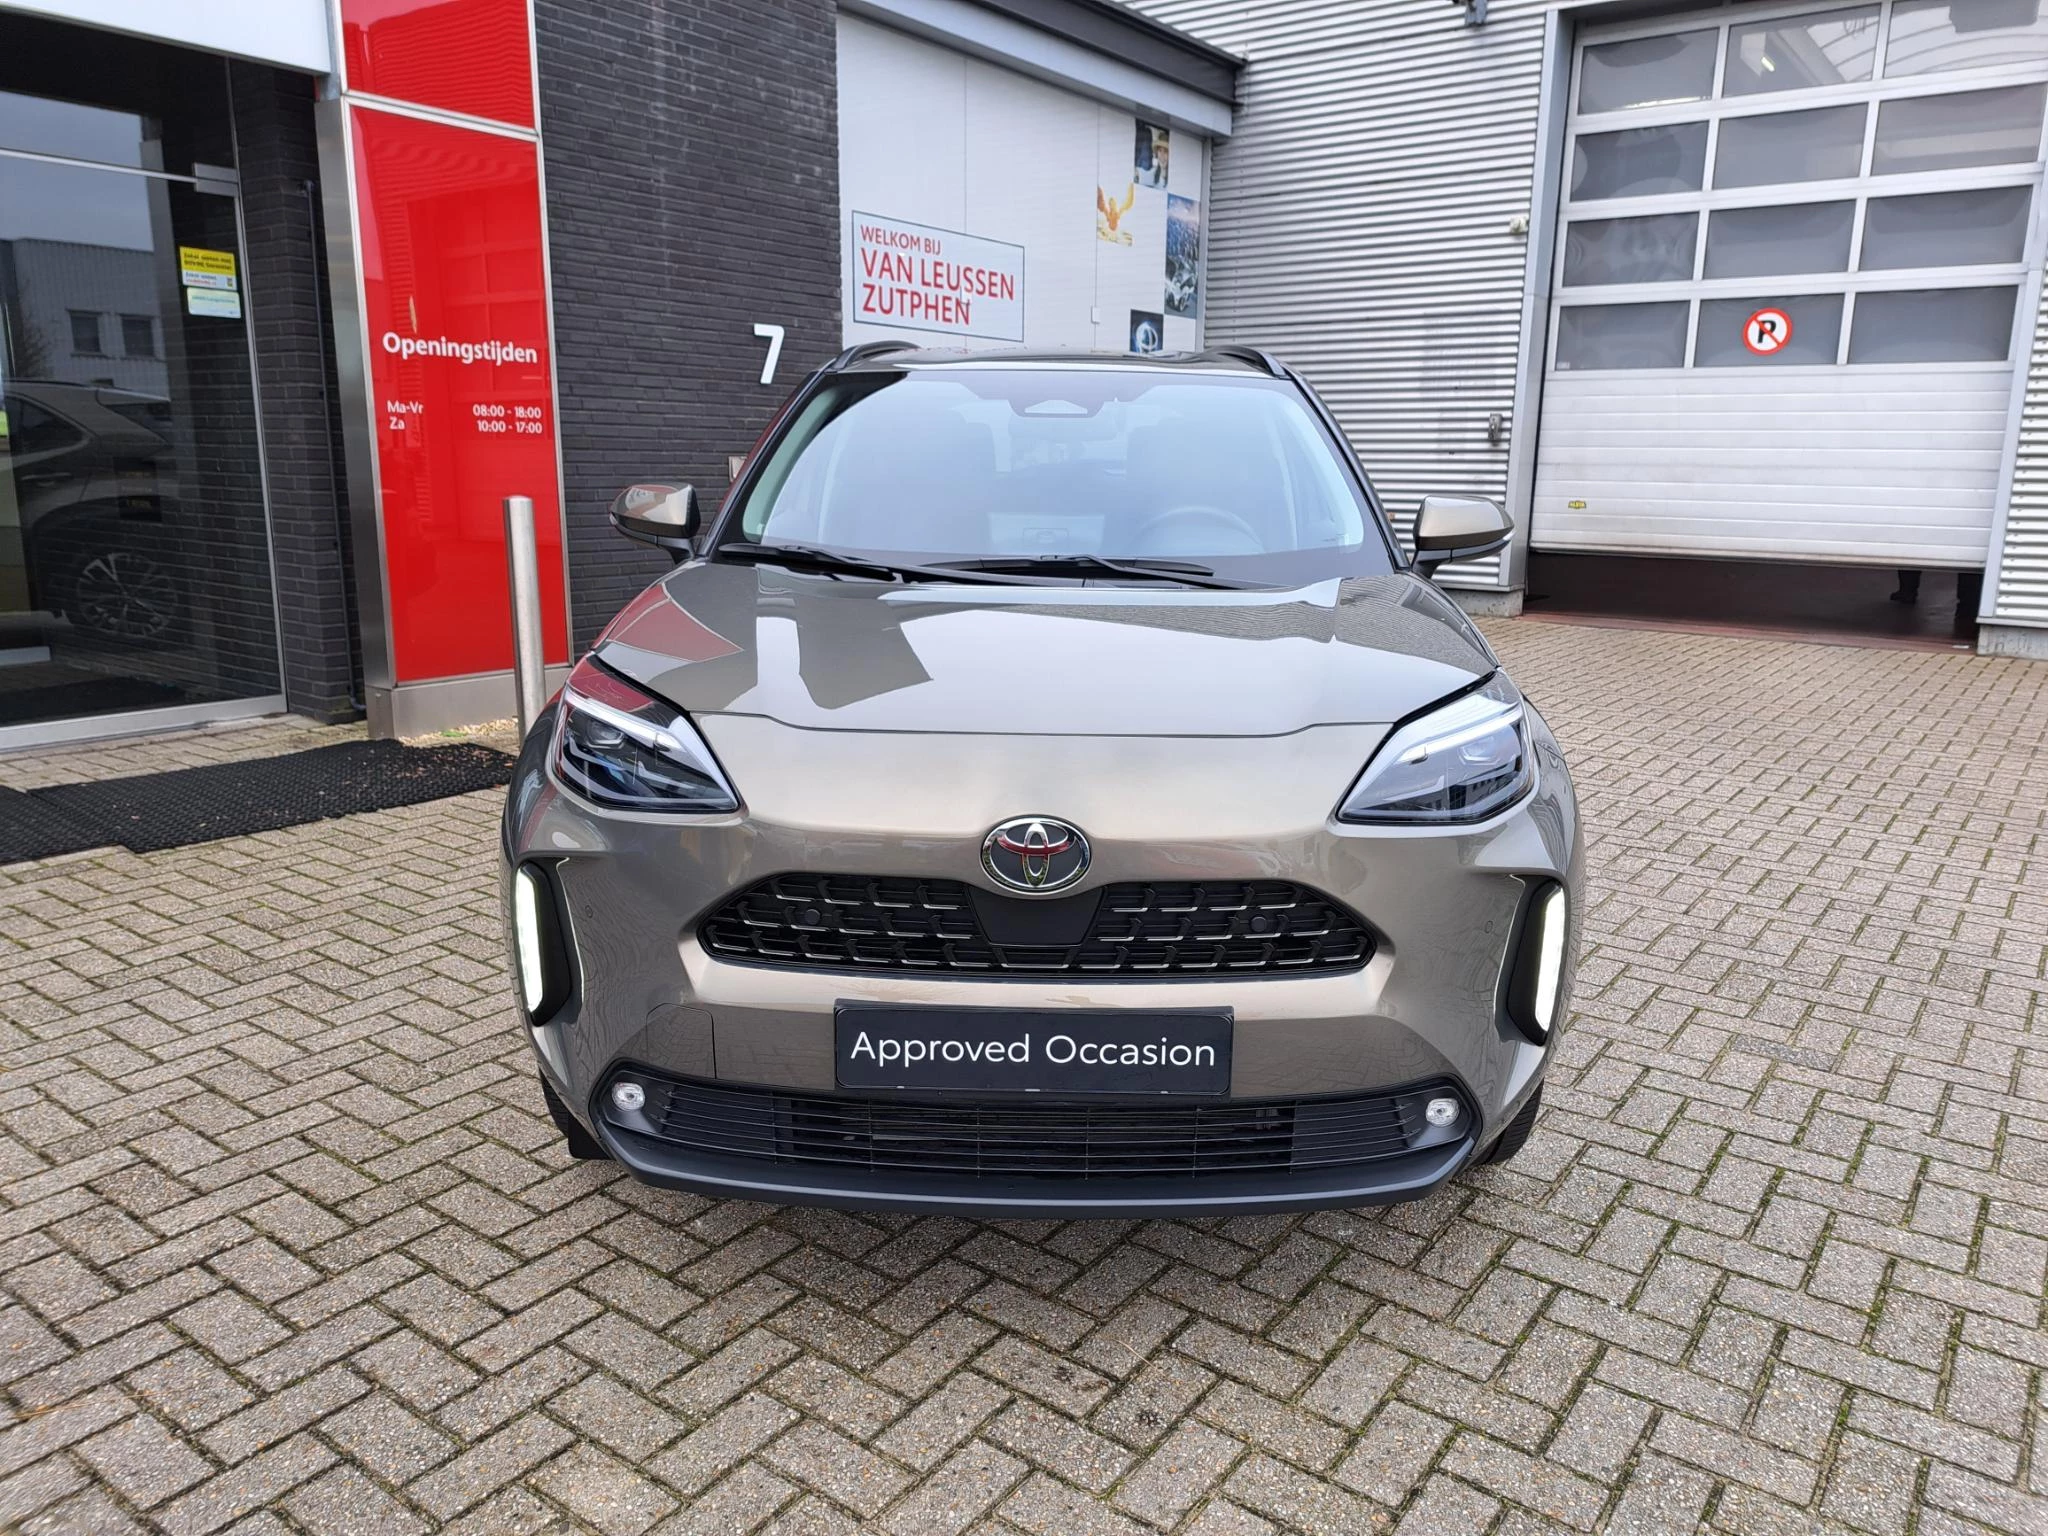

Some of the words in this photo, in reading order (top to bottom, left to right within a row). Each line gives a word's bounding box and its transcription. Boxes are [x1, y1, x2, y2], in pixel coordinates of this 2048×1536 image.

[860, 224, 920, 252] WELKOM
[924, 238, 941, 256] BIJ
[861, 247, 913, 284] VAN
[921, 258, 1015, 301] LEUSSEN
[862, 283, 970, 325] ZUTPHEN
[382, 331, 538, 366] Openingstijden
[754, 323, 785, 384] 7
[387, 400, 424, 414] Ma-Vr
[472, 404, 505, 417] 08:00
[515, 406, 542, 419] 18:00
[389, 416, 406, 430] Za
[477, 420, 506, 433] 10:00
[516, 422, 543, 434] 17:00
[850, 1031, 1030, 1067] Approved
[1045, 1034, 1215, 1067] Occasion
